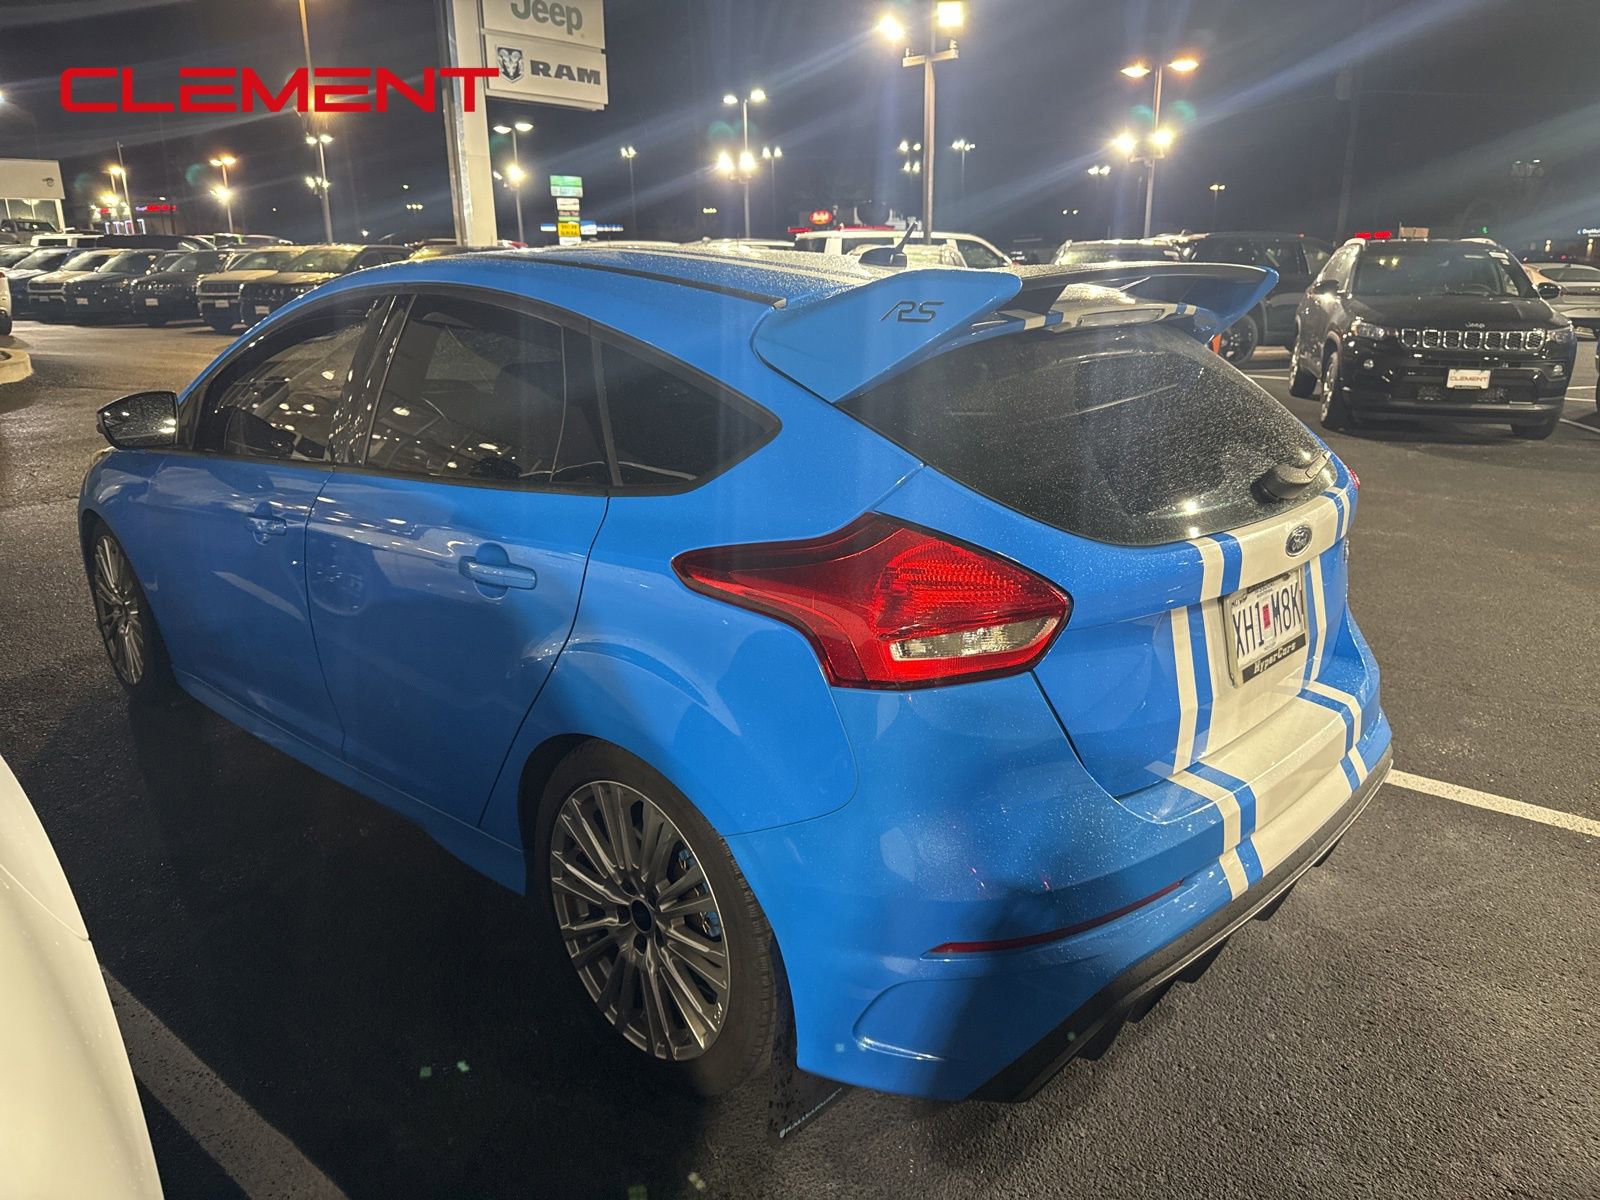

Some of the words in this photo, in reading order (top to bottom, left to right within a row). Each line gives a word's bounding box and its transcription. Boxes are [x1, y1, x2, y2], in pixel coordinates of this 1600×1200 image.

[511, 0, 583, 36] Jeep
[530, 60, 601, 86] RAM
[880, 300, 944, 323] RS
